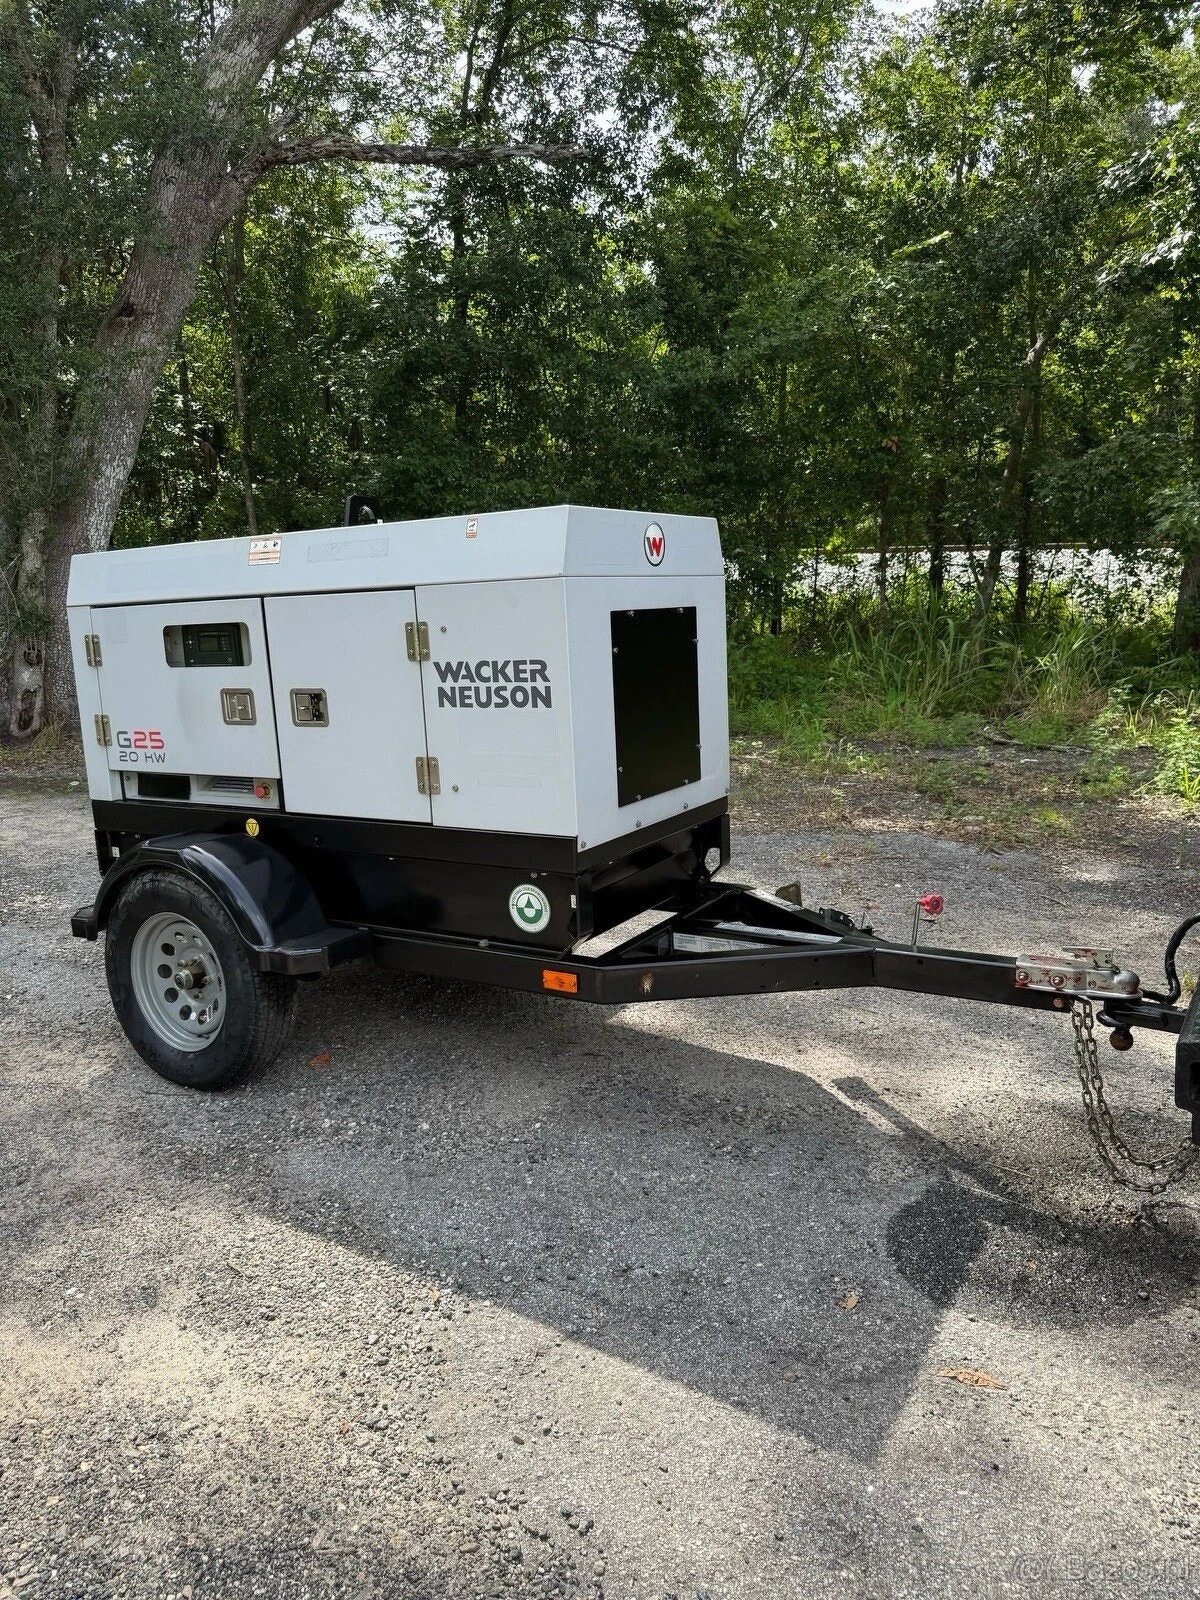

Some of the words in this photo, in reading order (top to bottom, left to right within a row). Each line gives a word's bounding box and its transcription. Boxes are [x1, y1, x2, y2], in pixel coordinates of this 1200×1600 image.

[433, 658, 551, 683] WACKER
[437, 685, 552, 709] NEUSON
[116, 730, 164, 749] G25
[119, 750, 138, 762] 20
